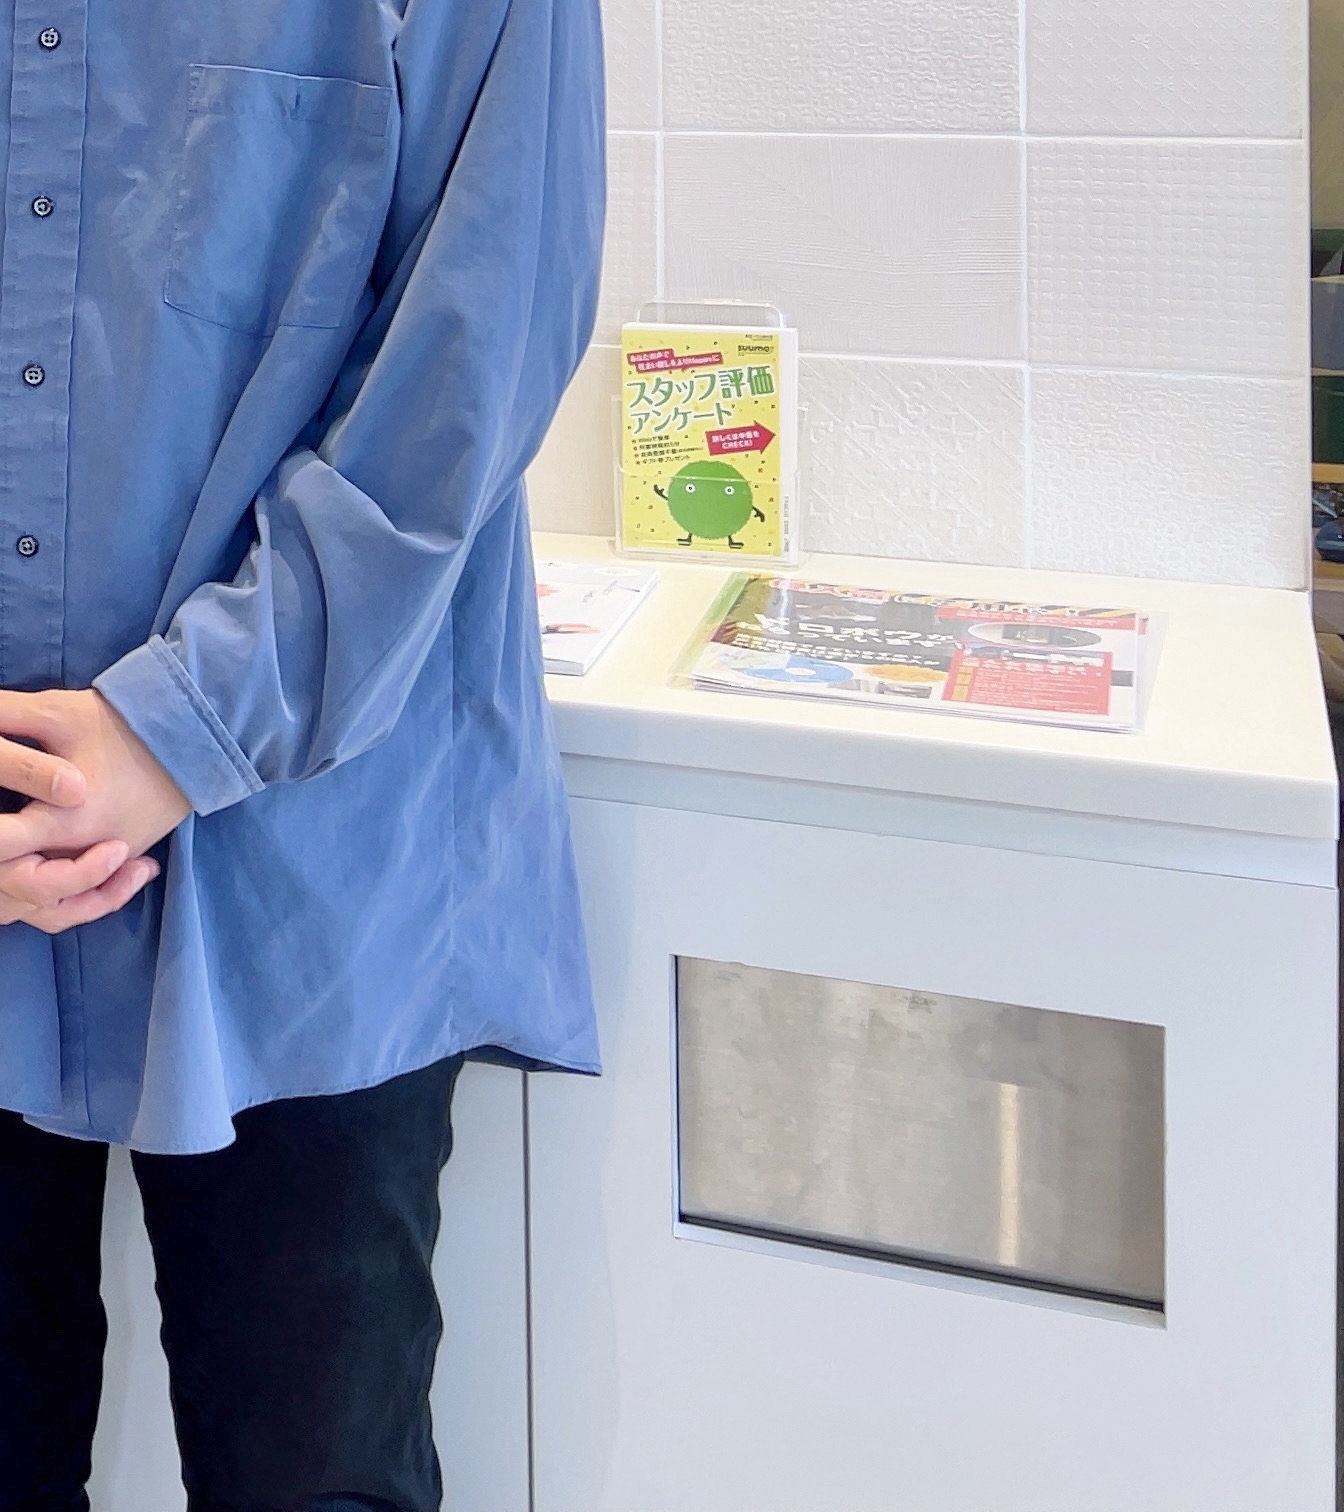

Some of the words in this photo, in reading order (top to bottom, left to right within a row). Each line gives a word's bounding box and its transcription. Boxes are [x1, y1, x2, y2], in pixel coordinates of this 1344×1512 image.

[626, 365, 775, 408] スタッフ評価
[630, 402, 732, 434] アンケート
